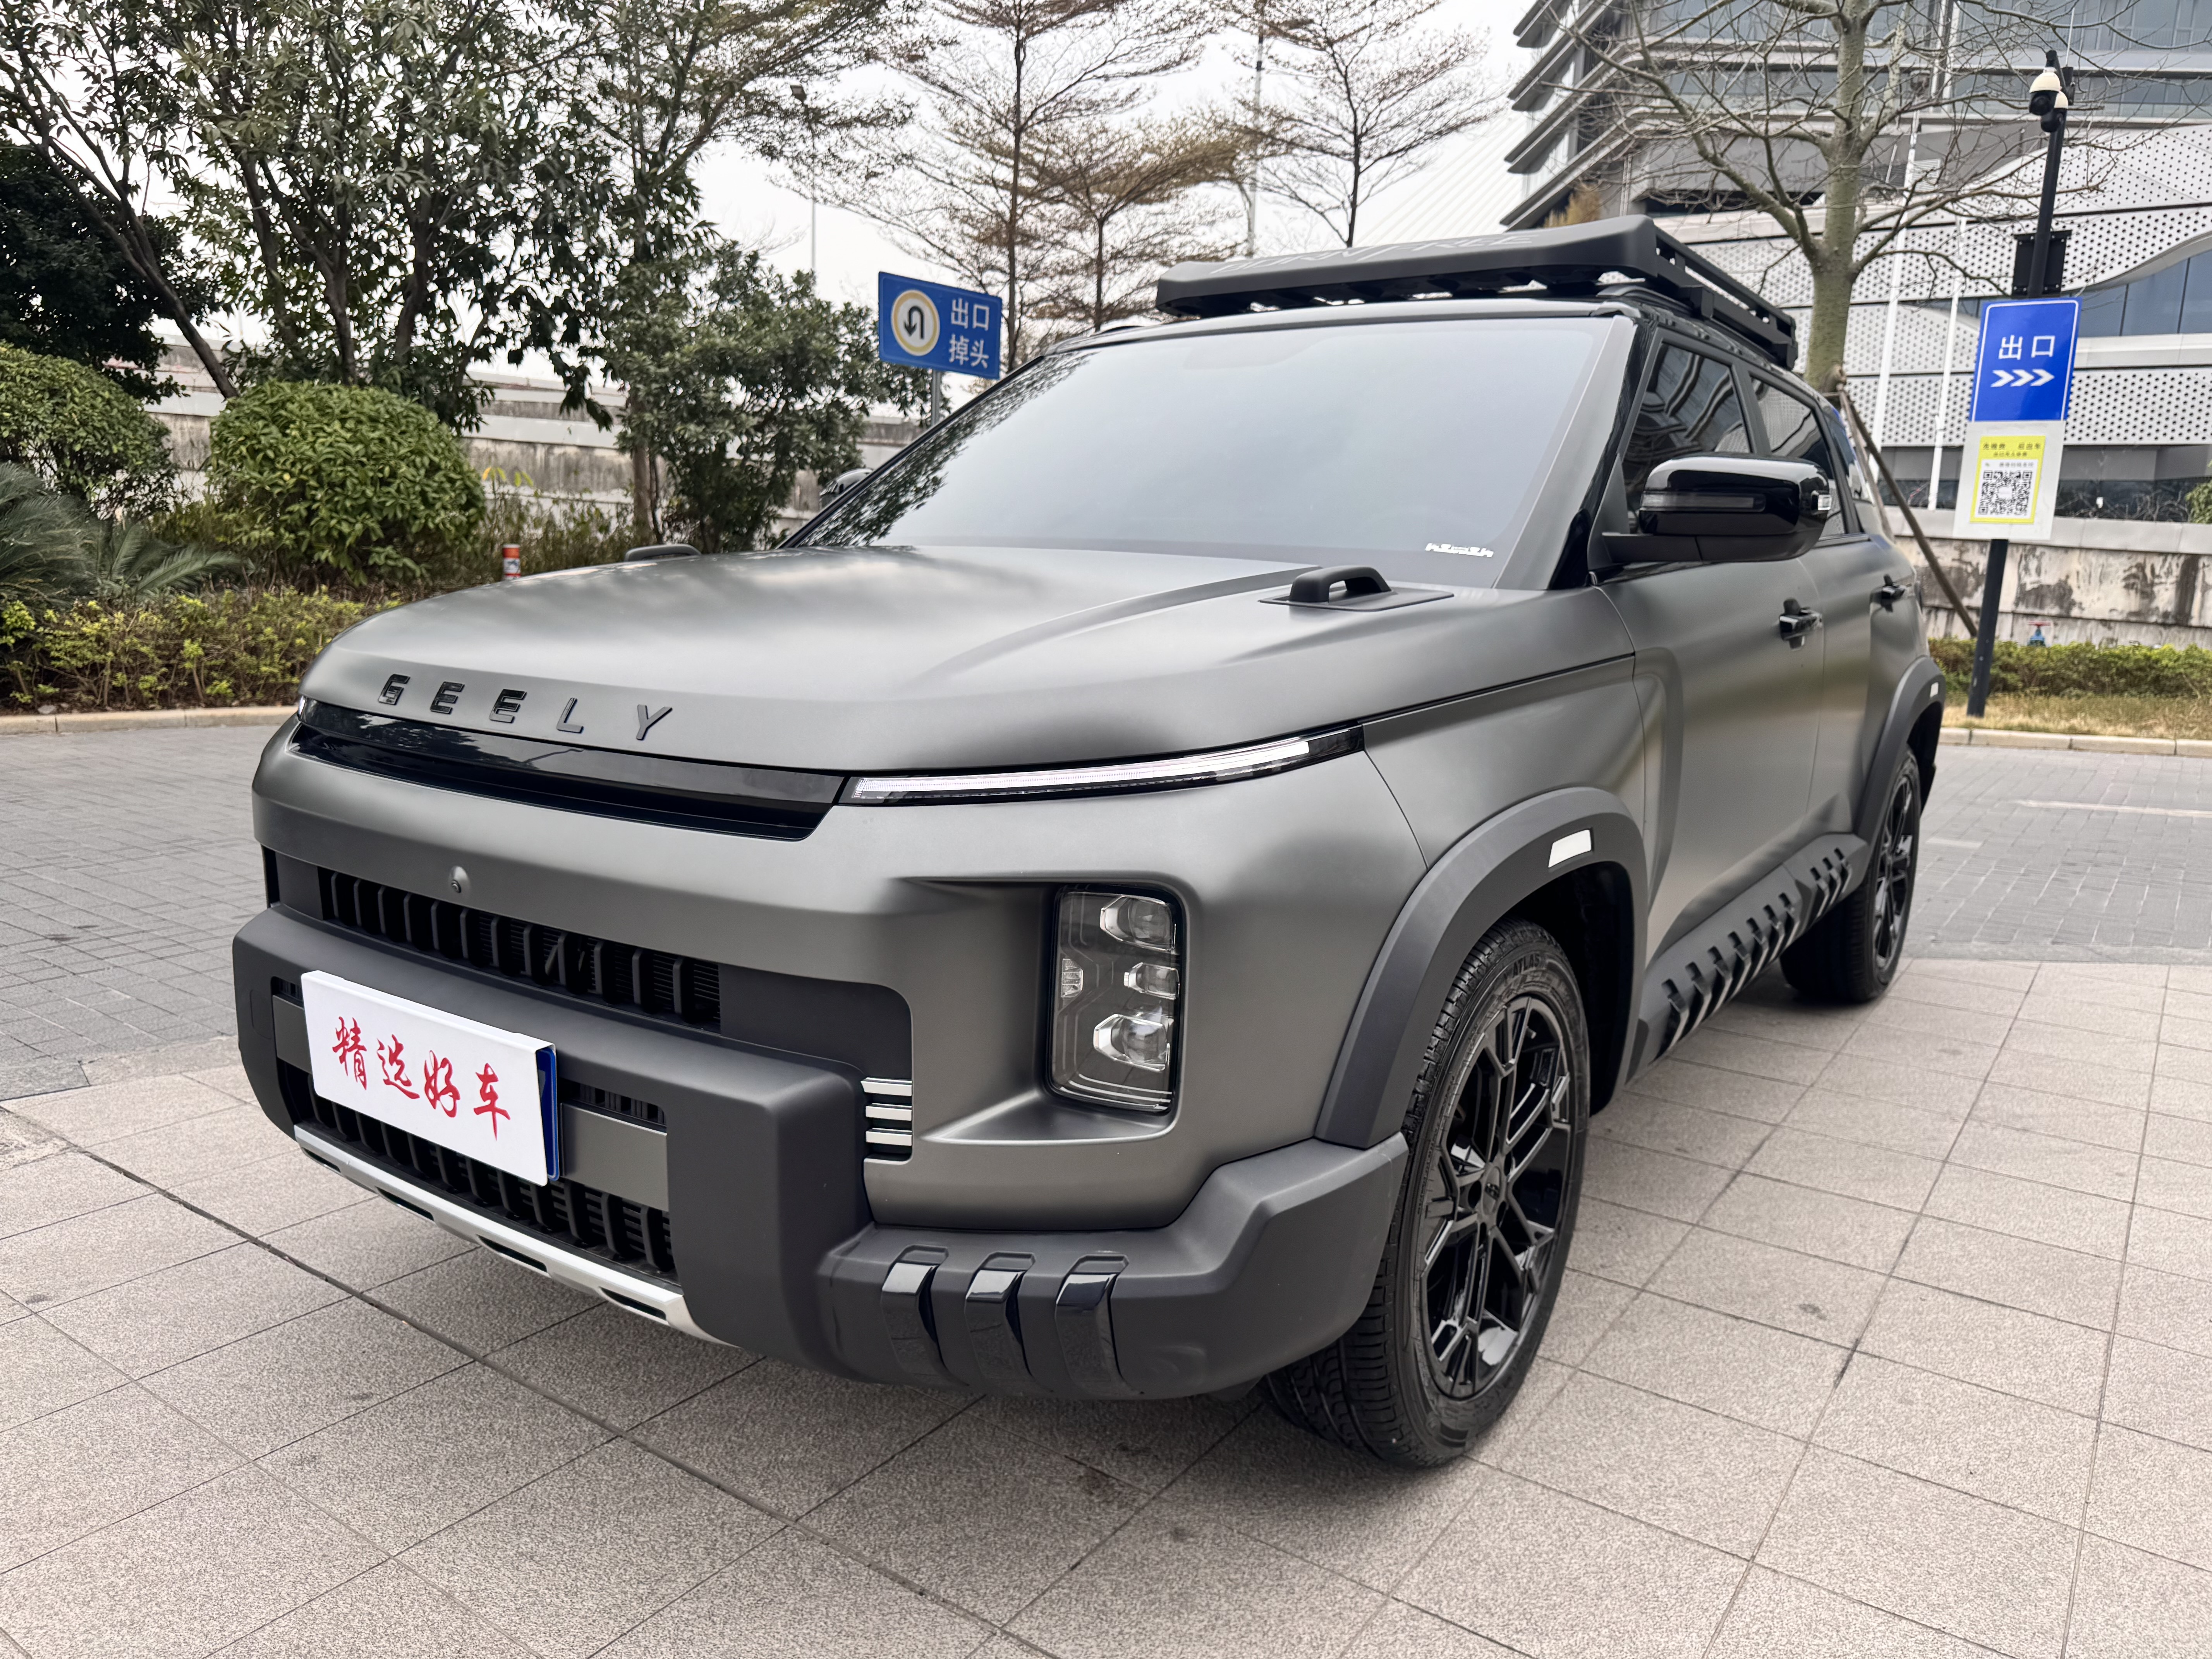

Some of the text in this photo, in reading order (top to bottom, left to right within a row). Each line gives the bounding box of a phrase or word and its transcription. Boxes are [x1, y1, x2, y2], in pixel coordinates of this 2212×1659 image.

[951, 297, 990, 331] 出口
[949, 333, 989, 369] 掉头
[1998, 334, 2055, 360] 出口
[378, 673, 673, 741] GEELY
[1513, 953, 1542, 978] ATLAS
[332, 1016, 511, 1141] 精选好车
